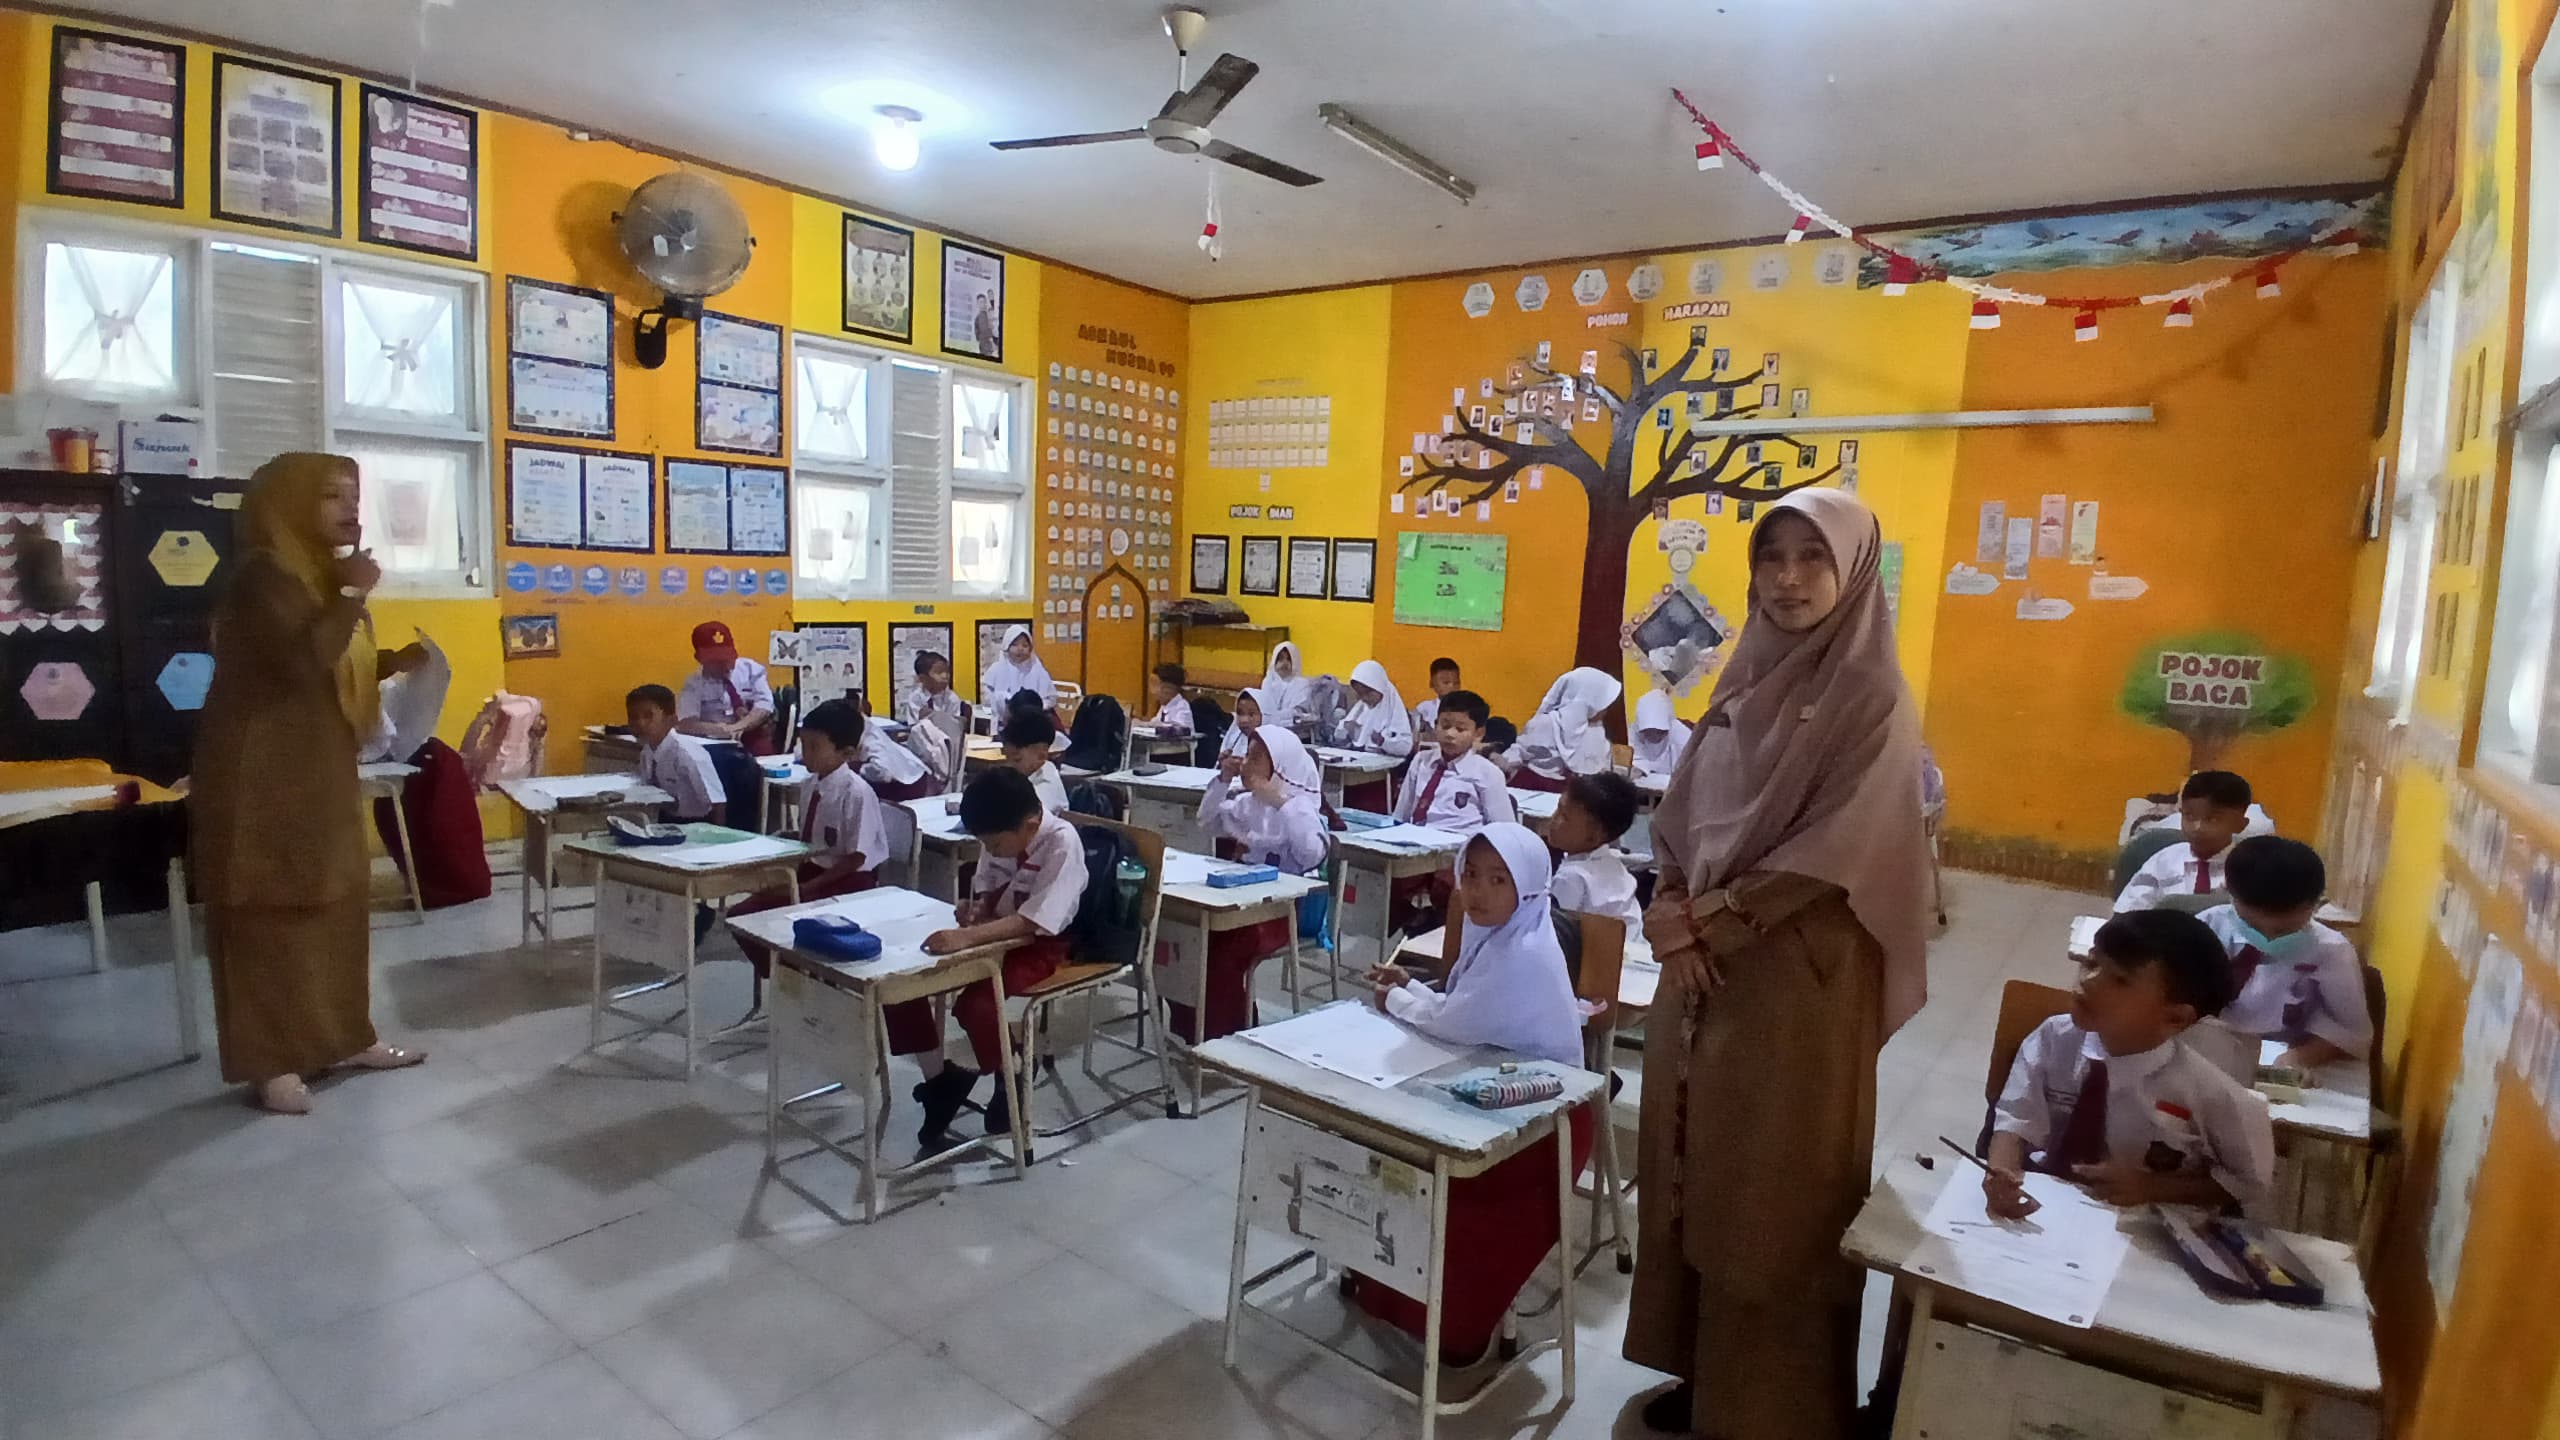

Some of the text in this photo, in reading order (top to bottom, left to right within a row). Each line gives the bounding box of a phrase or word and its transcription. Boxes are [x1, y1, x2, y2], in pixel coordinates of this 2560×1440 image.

[1663, 301, 1730, 321] HARAPAN
[2160, 655, 2262, 680] POJOK
[2169, 682, 2248, 705] BACA
